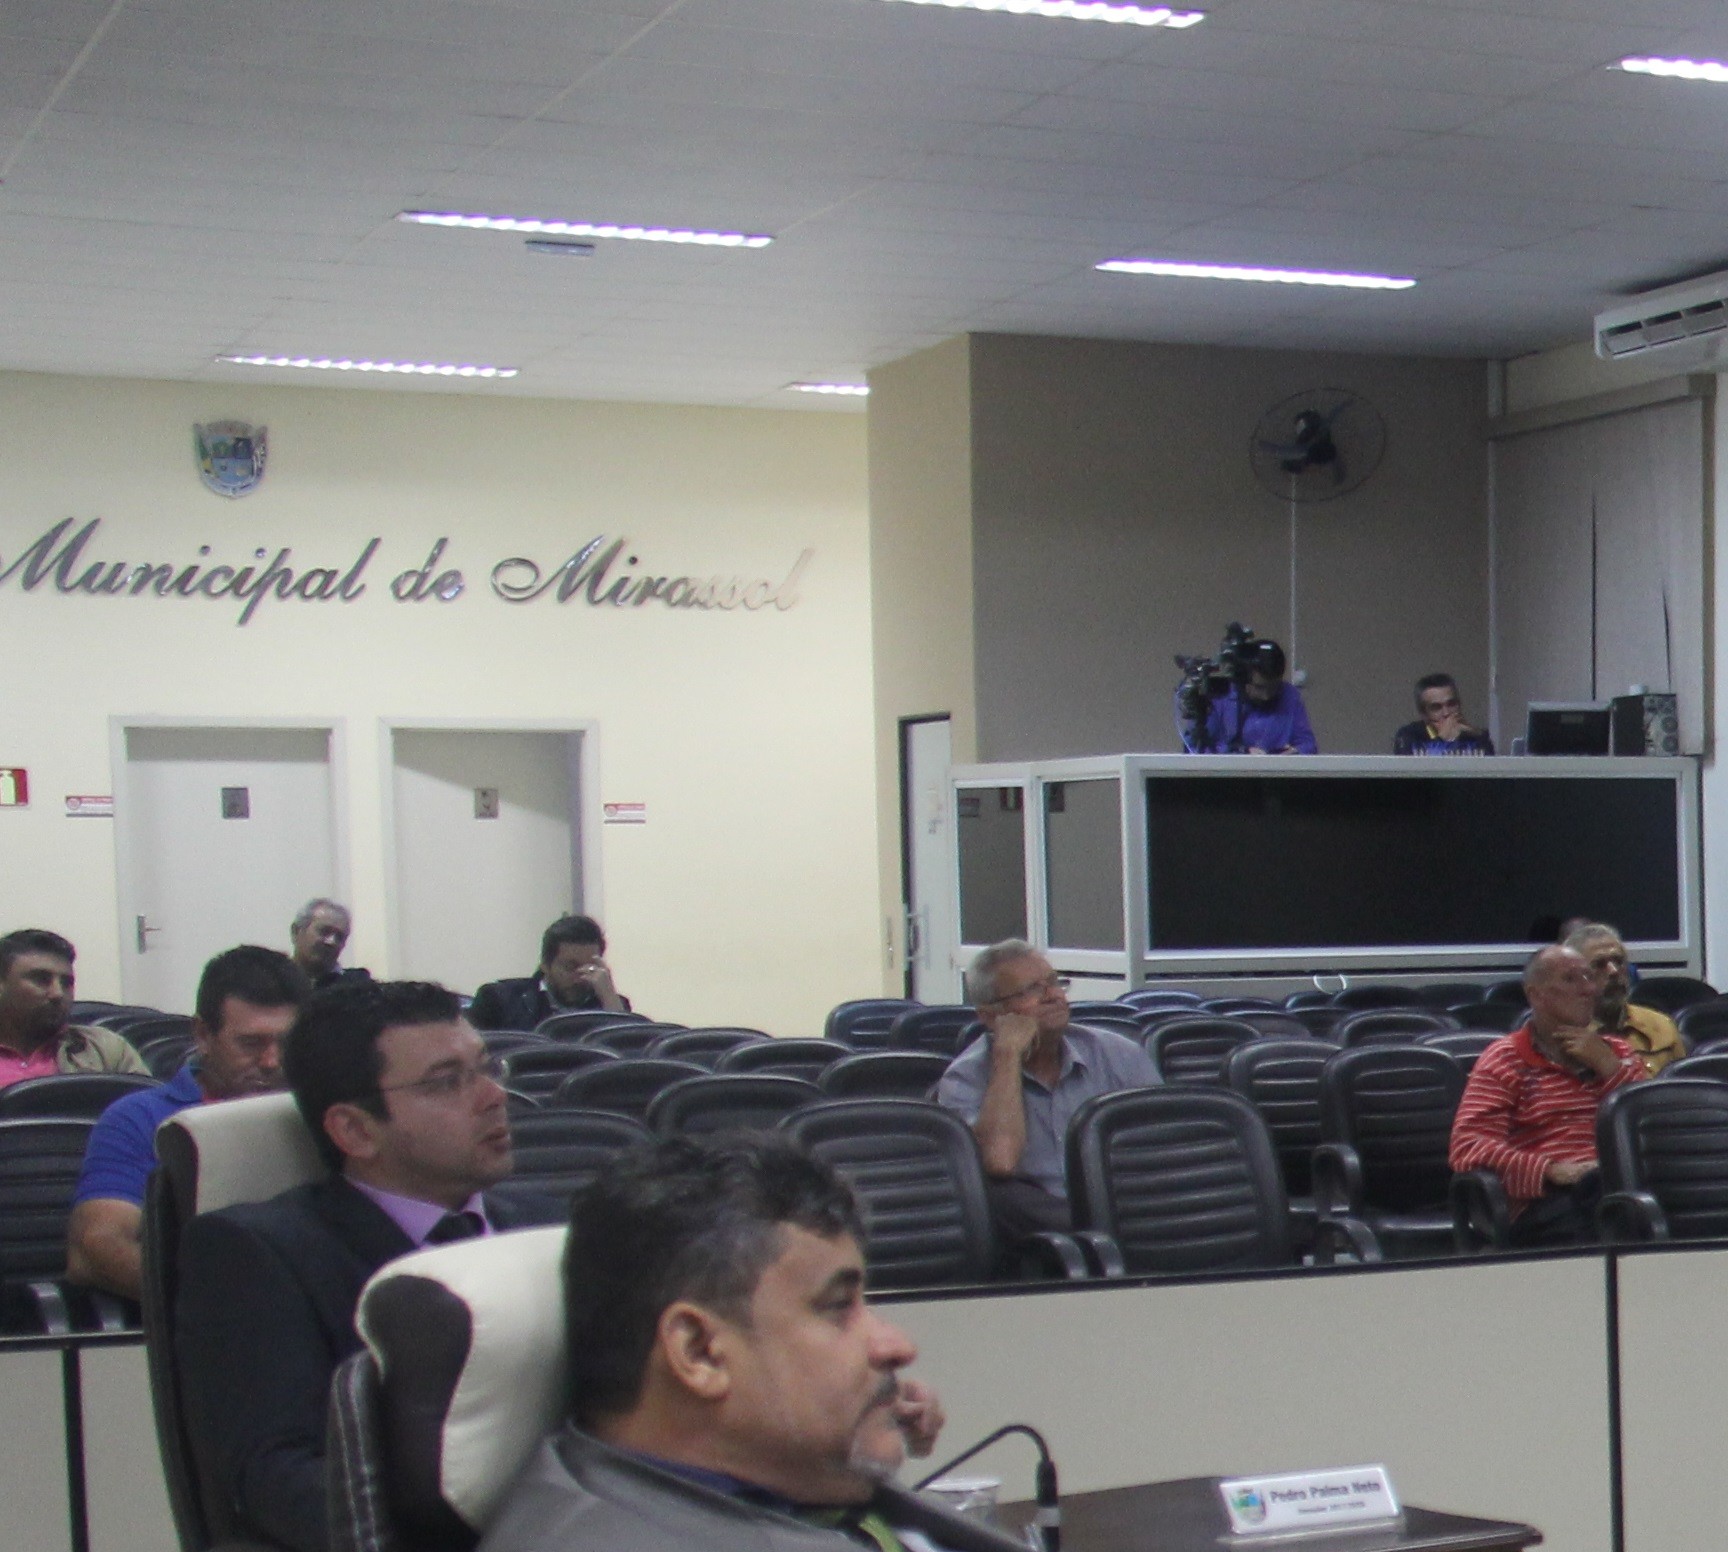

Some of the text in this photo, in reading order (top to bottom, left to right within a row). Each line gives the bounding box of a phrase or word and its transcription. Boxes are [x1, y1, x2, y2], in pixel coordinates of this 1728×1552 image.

[0, 516, 814, 626] Municipal de Mirassol
